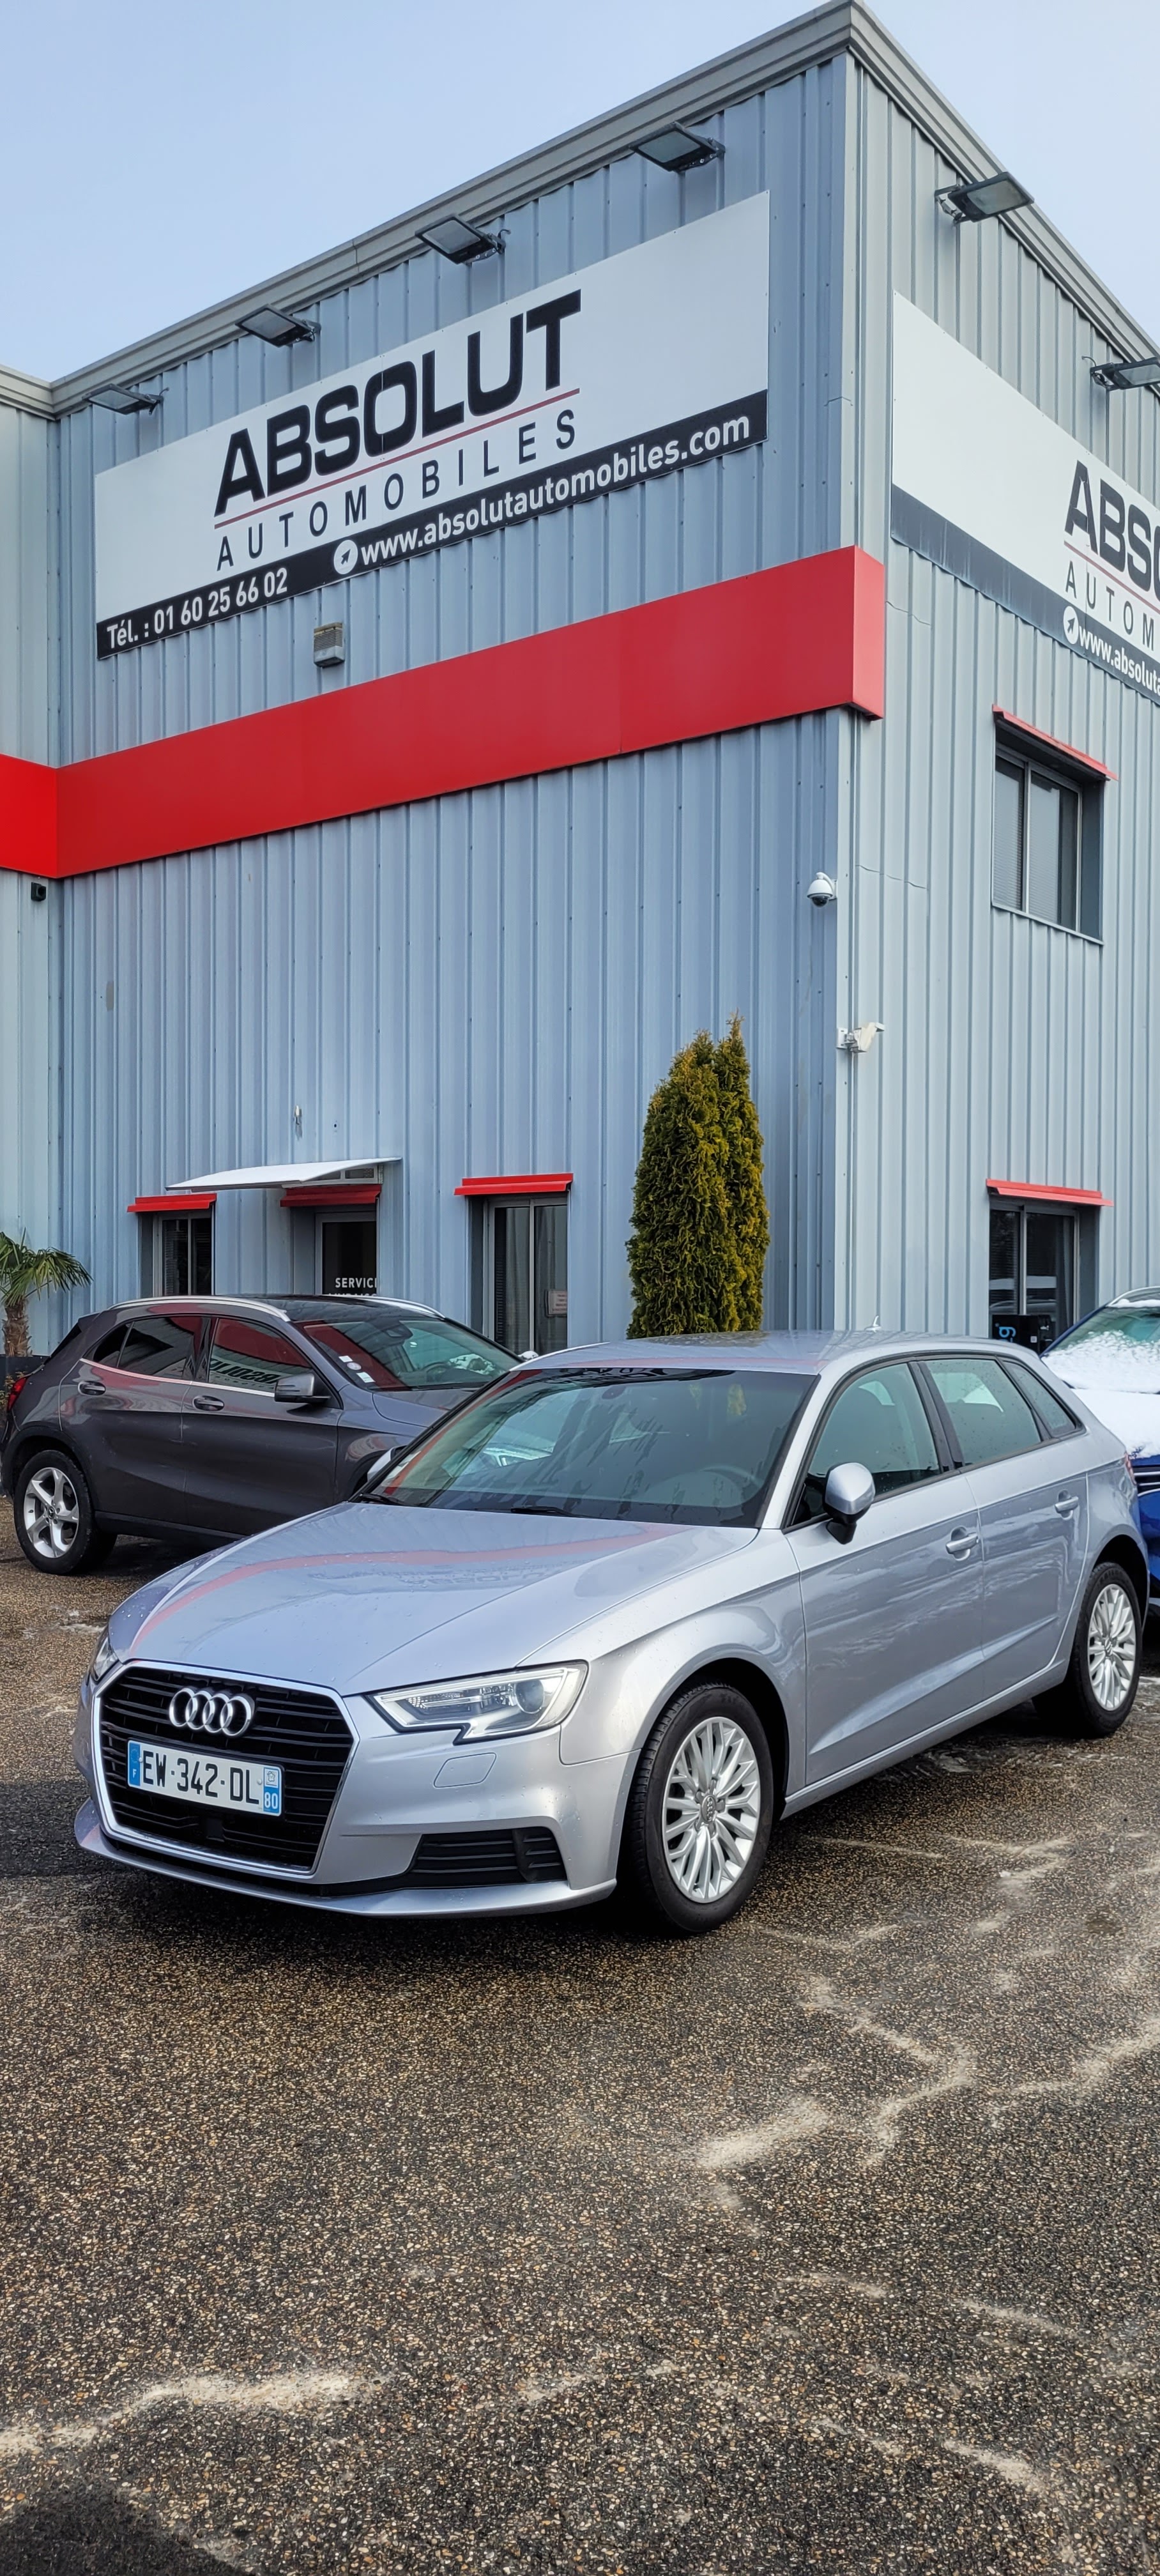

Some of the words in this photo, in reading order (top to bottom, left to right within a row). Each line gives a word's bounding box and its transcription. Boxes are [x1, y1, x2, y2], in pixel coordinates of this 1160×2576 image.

[214, 289, 581, 517] ABSOLUT
[217, 409, 575, 571] AUTOMOBILES
[361, 416, 749, 565] www.absolutautomobiles.com
[107, 620, 139, 648] Tél.
[155, 606, 173, 634] 01
[181, 597, 202, 625] 60
[208, 586, 230, 617] 25
[236, 577, 259, 606] 66
[264, 567, 287, 597] 02
[1065, 560, 1154, 651] AUTOM
[132, 1768, 137, 1779] F
[264, 1791, 279, 1809] 80
